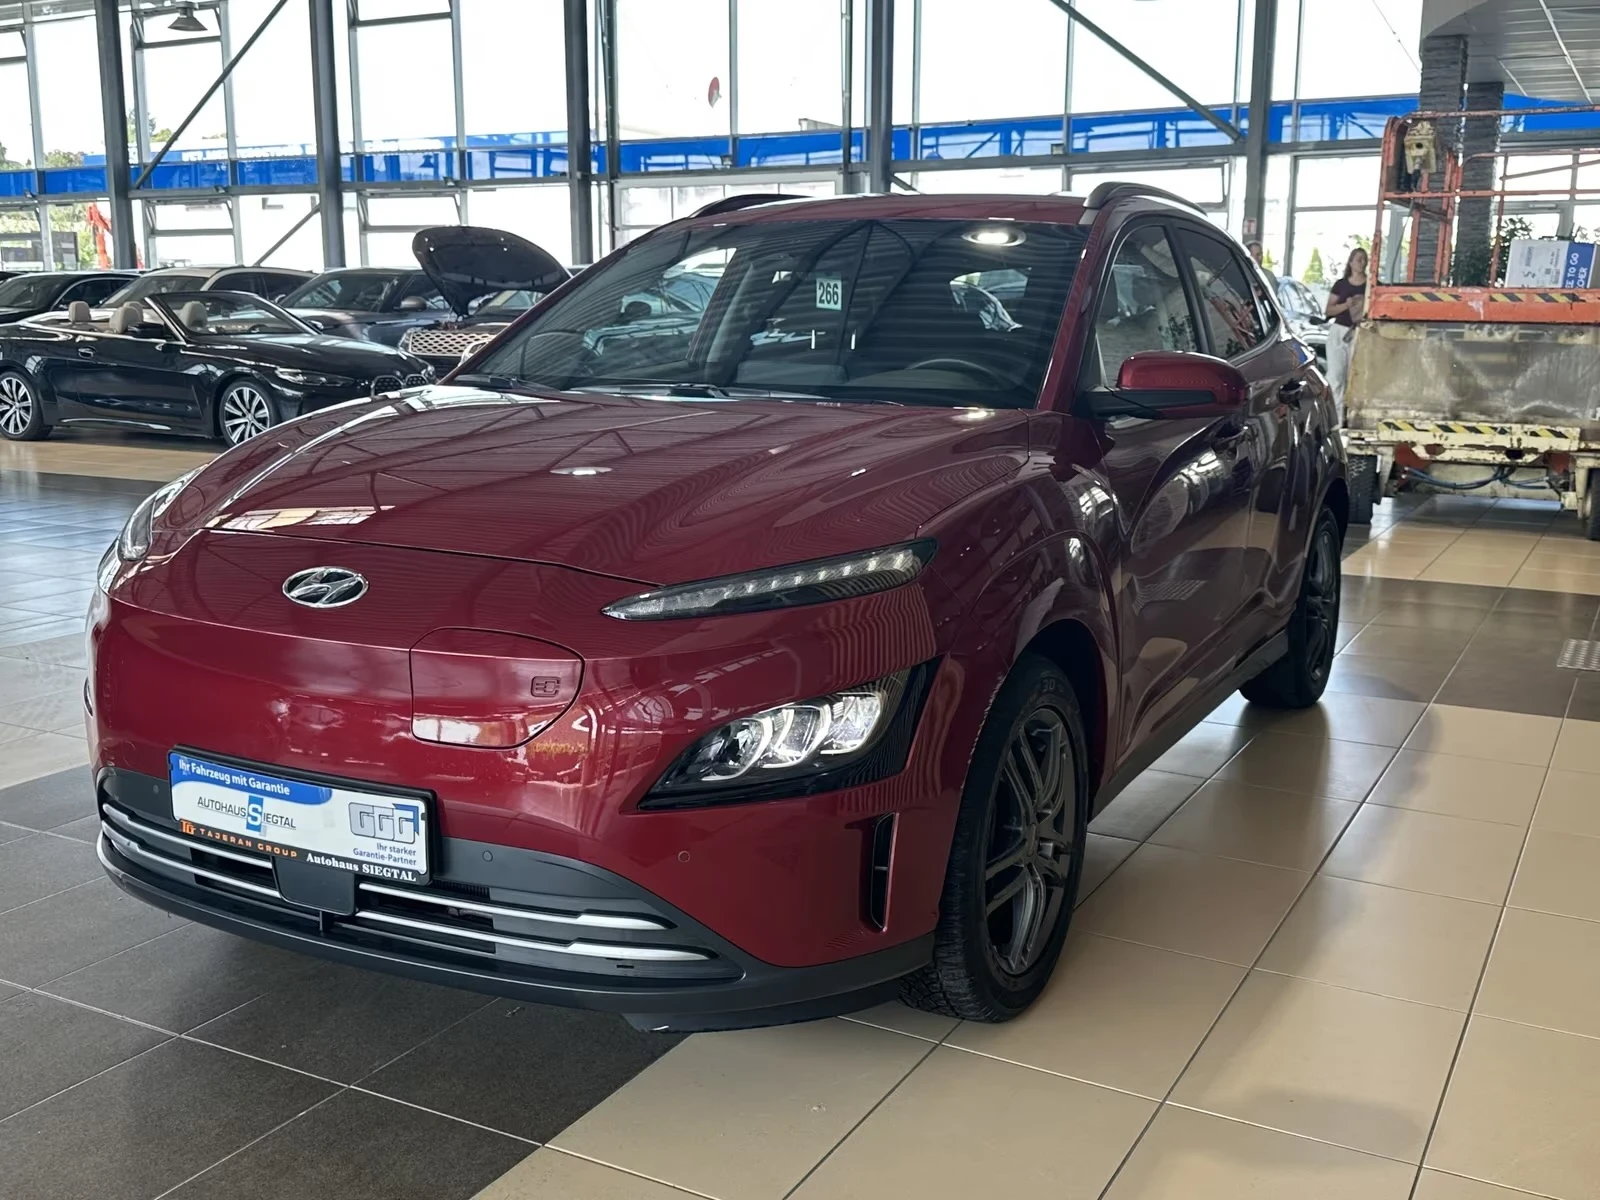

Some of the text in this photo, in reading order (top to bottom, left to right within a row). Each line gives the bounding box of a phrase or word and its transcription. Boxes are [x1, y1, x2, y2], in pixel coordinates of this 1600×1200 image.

[1569, 252, 1579, 265] GO
[1567, 266, 1576, 277] TO
[818, 281, 839, 306] 266
[179, 759, 291, 796] Ihr Fahrzeug mit Garantie
[197, 796, 247, 817] AUTOHAUS
[199, 828, 298, 858] TAJERAN GROUP
[376, 842, 417, 856] Ihr starker
[306, 852, 417, 882] Autohaus SIEGTAL
[352, 847, 417, 866] Garantie-Partner
